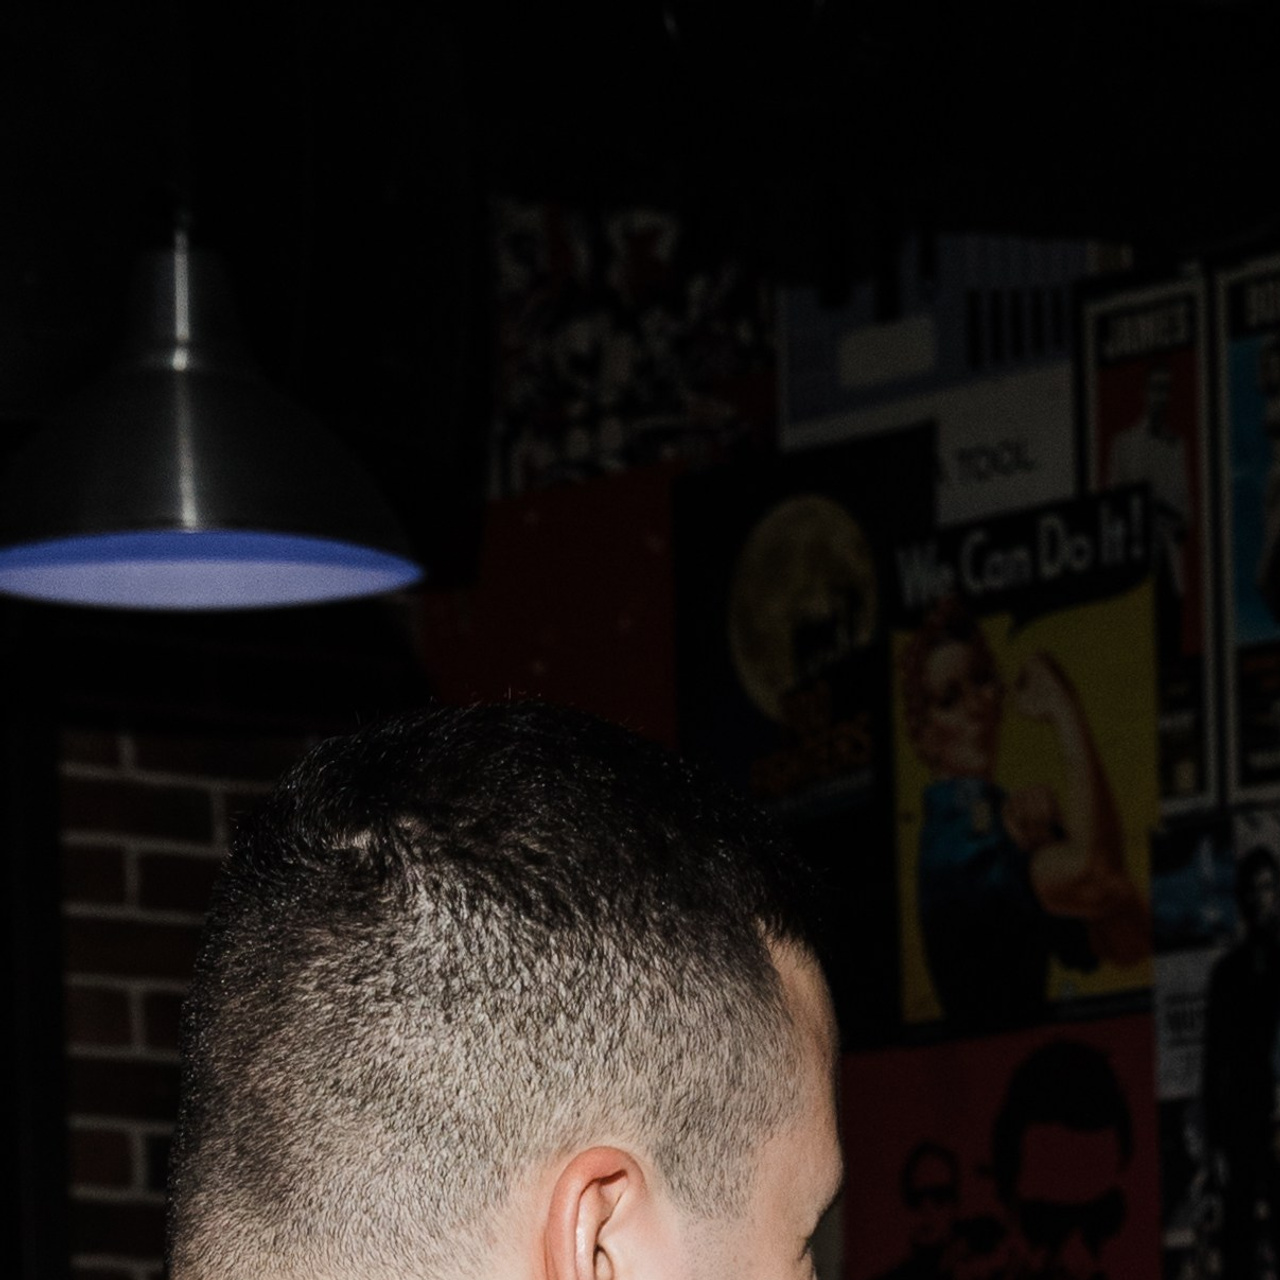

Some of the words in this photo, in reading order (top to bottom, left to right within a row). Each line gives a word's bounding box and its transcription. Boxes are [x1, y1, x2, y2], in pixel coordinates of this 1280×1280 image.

[895, 539, 954, 609] We
[959, 527, 1033, 596] Can
[1036, 512, 1095, 580] Do
[1099, 494, 1146, 566] It!
